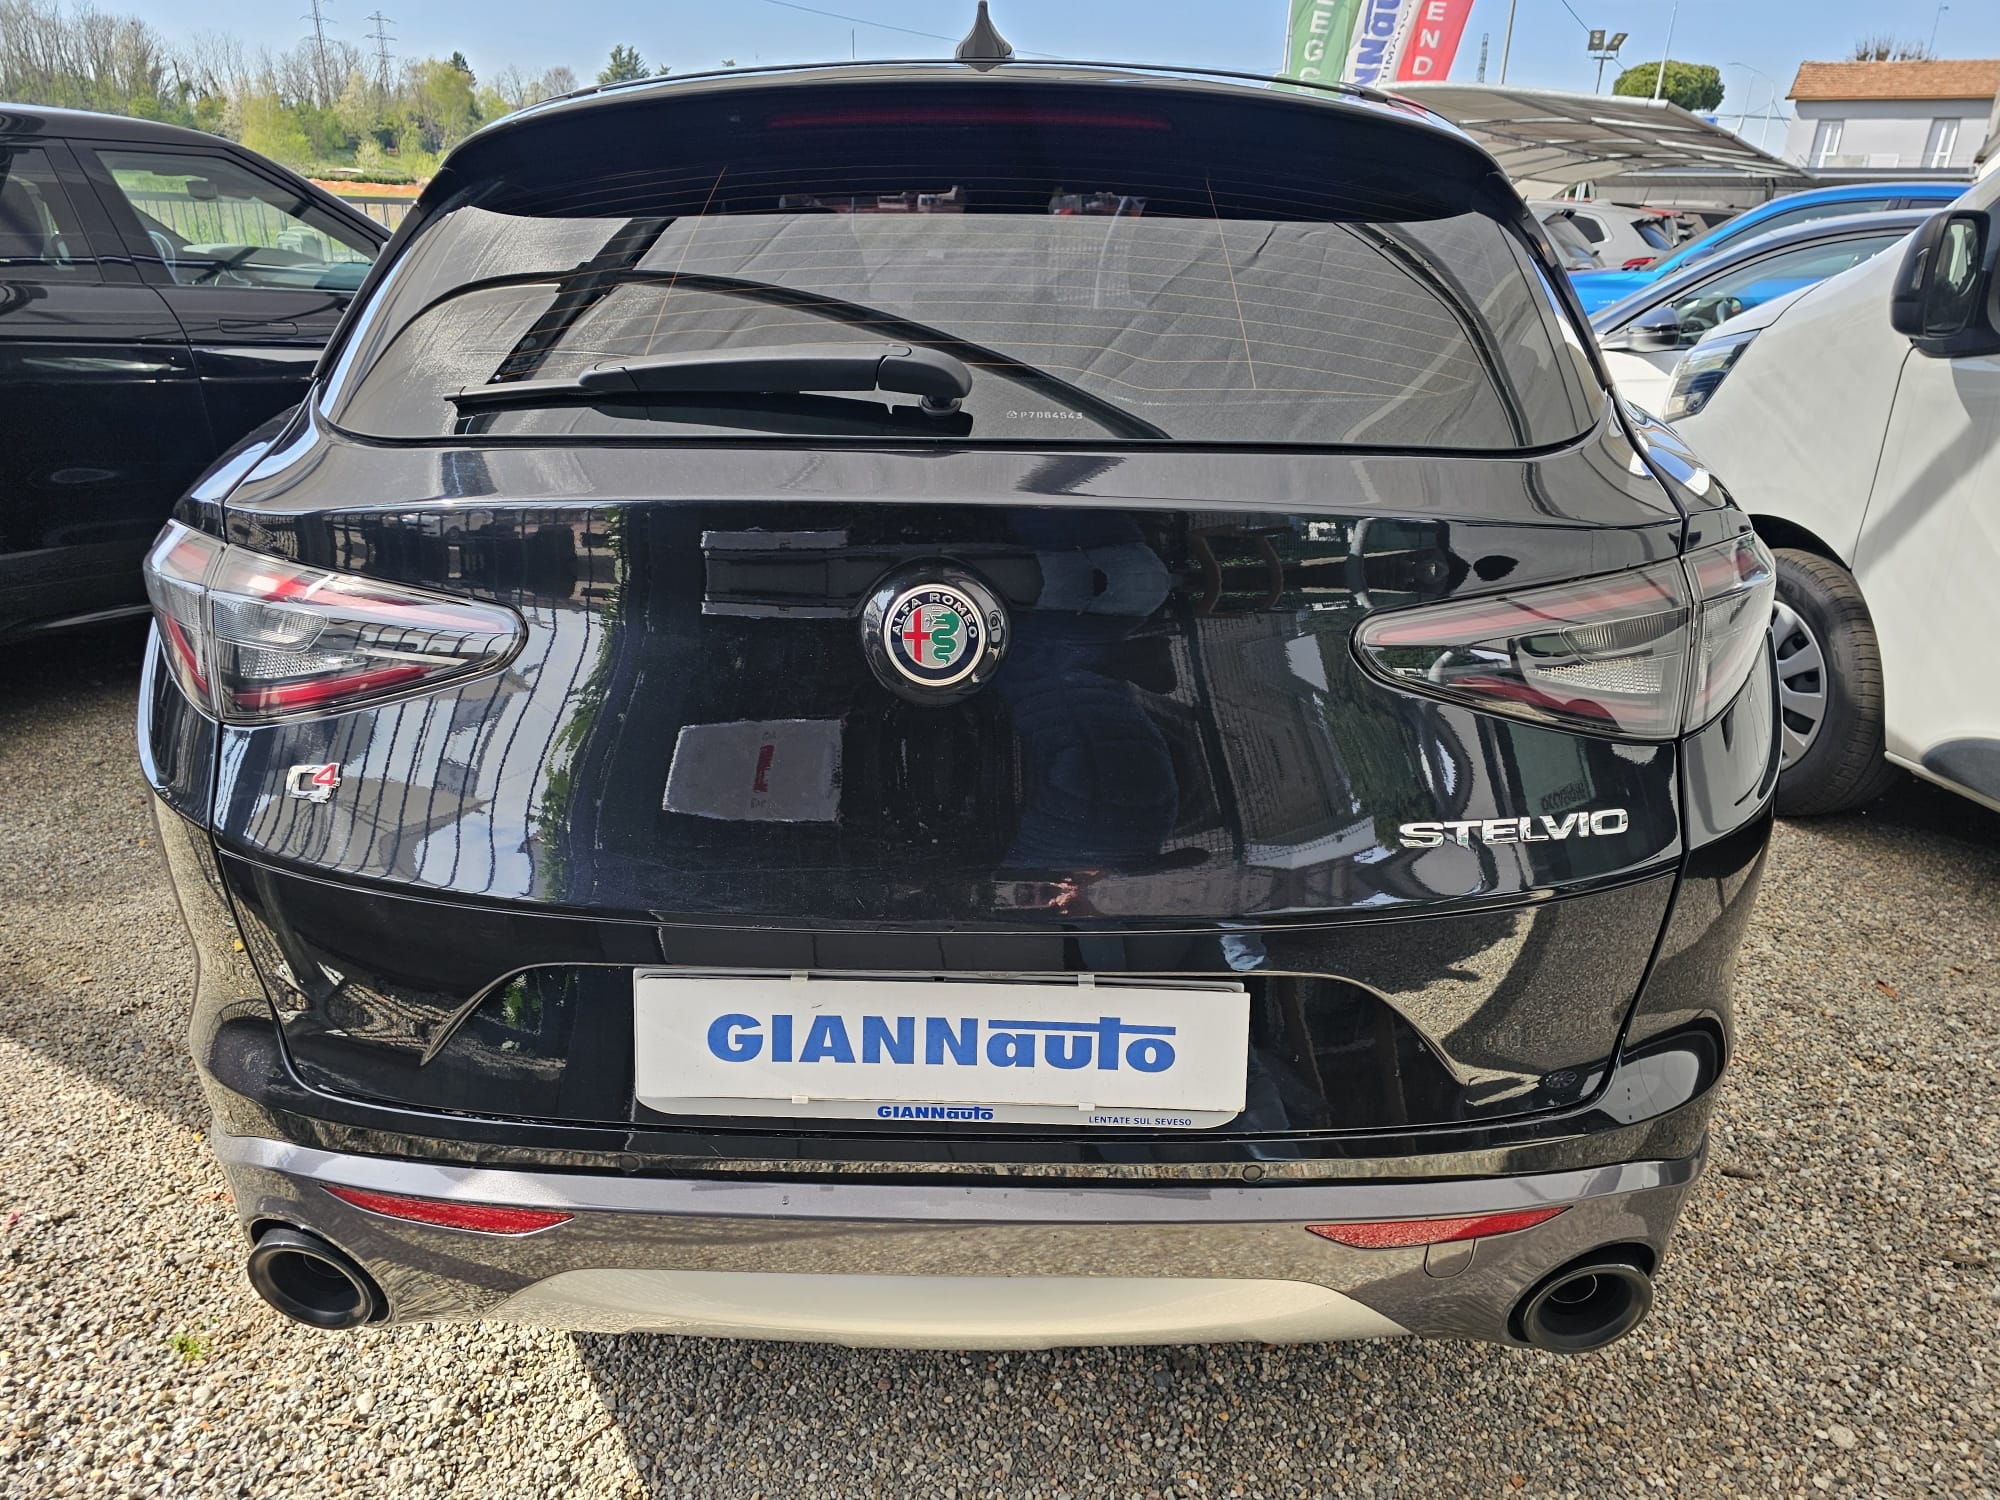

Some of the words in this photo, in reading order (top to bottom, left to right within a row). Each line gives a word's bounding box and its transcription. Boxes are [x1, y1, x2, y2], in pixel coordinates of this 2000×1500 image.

[892, 598, 922, 636] ALFA
[929, 592, 978, 638] ROMEO
[285, 762, 341, 804] Q4
[1399, 808, 1629, 849] STELVIO
[707, 1013, 1176, 1073] GIANNauto
[877, 1105, 994, 1121] GIANNauto
[1088, 1115, 1131, 1125] LENTATE
[1133, 1116, 1153, 1126] SUL
[1154, 1117, 1192, 1127] SEVESO
